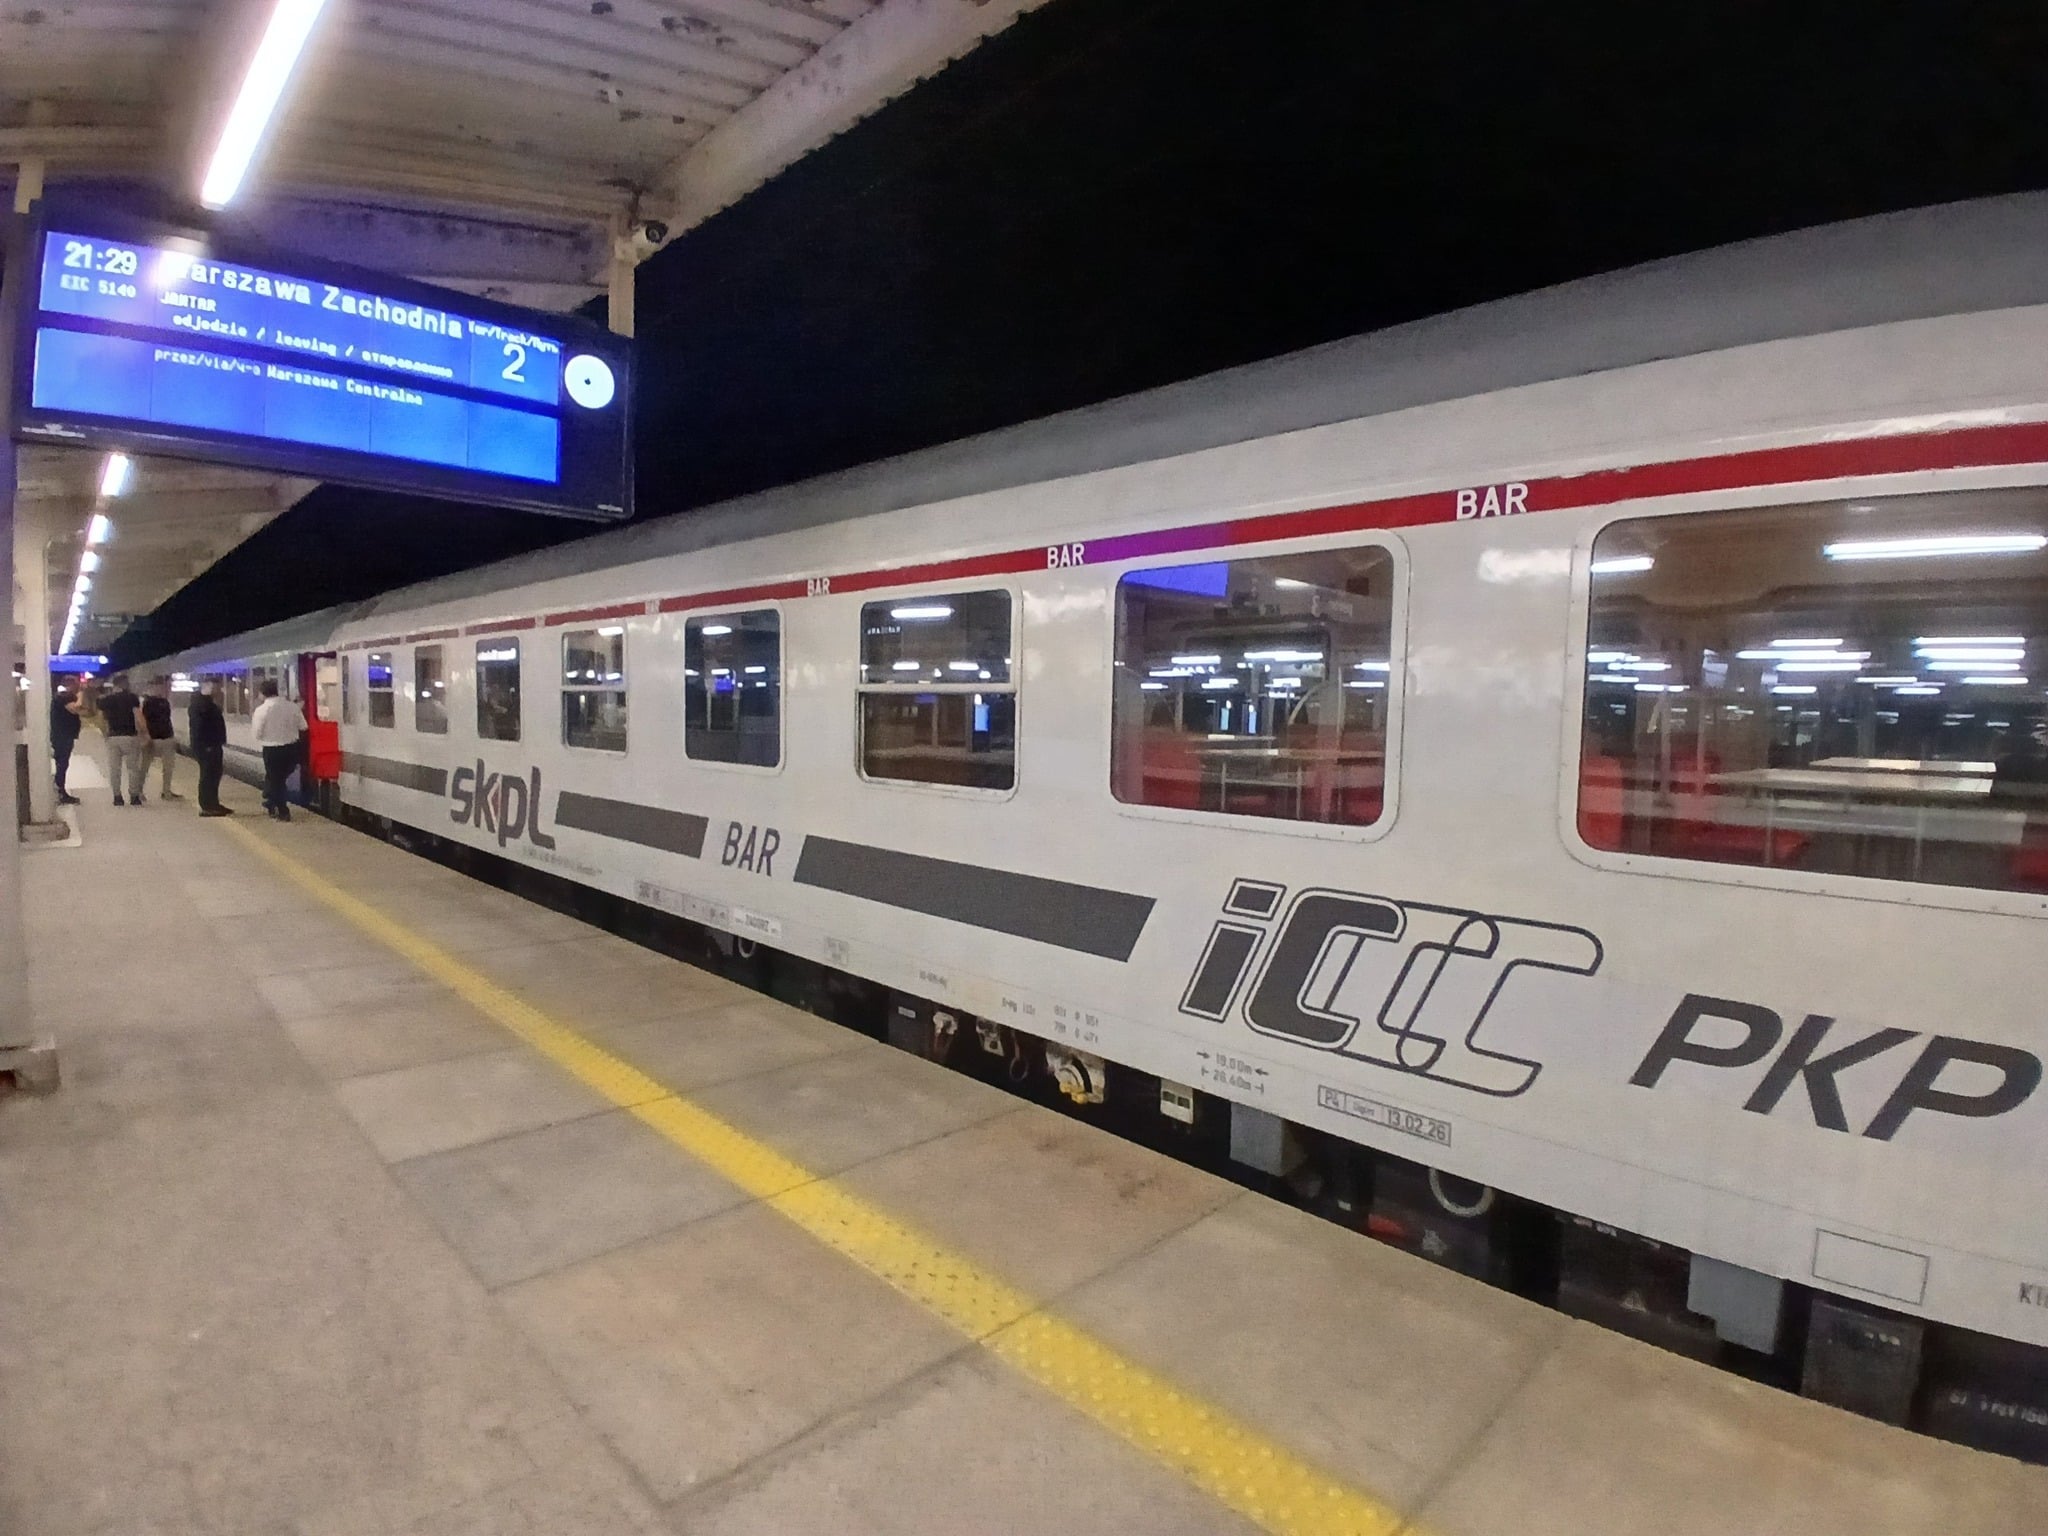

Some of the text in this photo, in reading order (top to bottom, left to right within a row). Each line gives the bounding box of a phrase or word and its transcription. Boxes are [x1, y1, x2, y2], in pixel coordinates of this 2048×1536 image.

[64, 241, 137, 275] 21:29
[99, 279, 136, 298] 5140
[163, 250, 462, 339] arszawa Zachodnia
[502, 342, 526, 383] 2
[1457, 484, 1528, 520] BAR
[1048, 543, 1084, 569] BAR
[807, 578, 830, 596] BAR
[722, 821, 780, 877] BAR
[1629, 992, 2043, 1142] PKP
